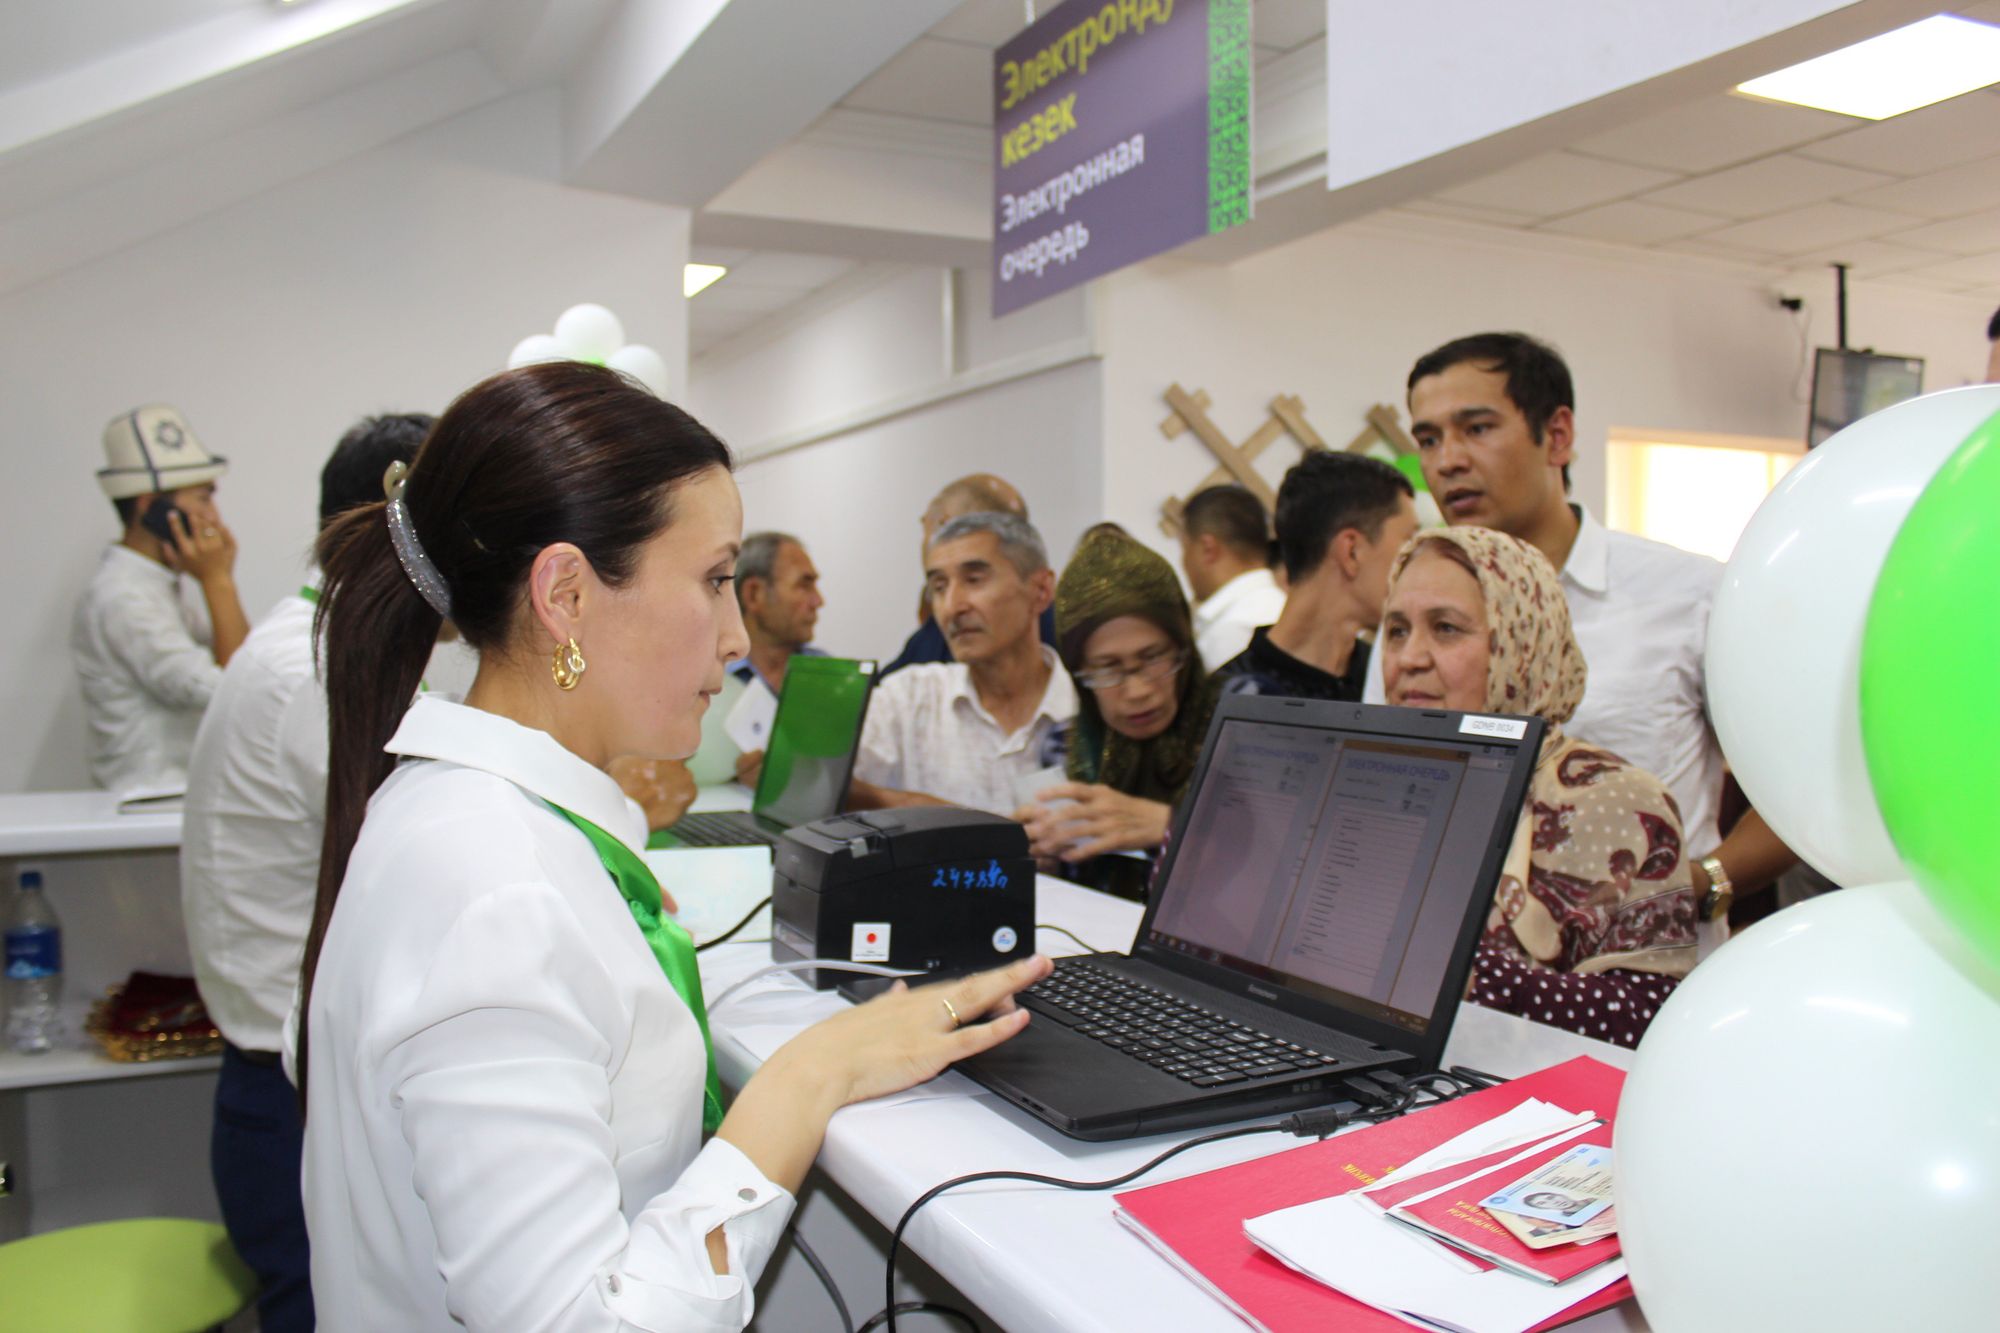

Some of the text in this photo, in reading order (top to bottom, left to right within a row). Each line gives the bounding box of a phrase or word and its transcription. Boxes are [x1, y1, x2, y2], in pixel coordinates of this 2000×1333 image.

[1002, 92, 1077, 168] кезек
[1001, 133, 1145, 232] Электронная
[1001, 221, 1090, 281] очередь
